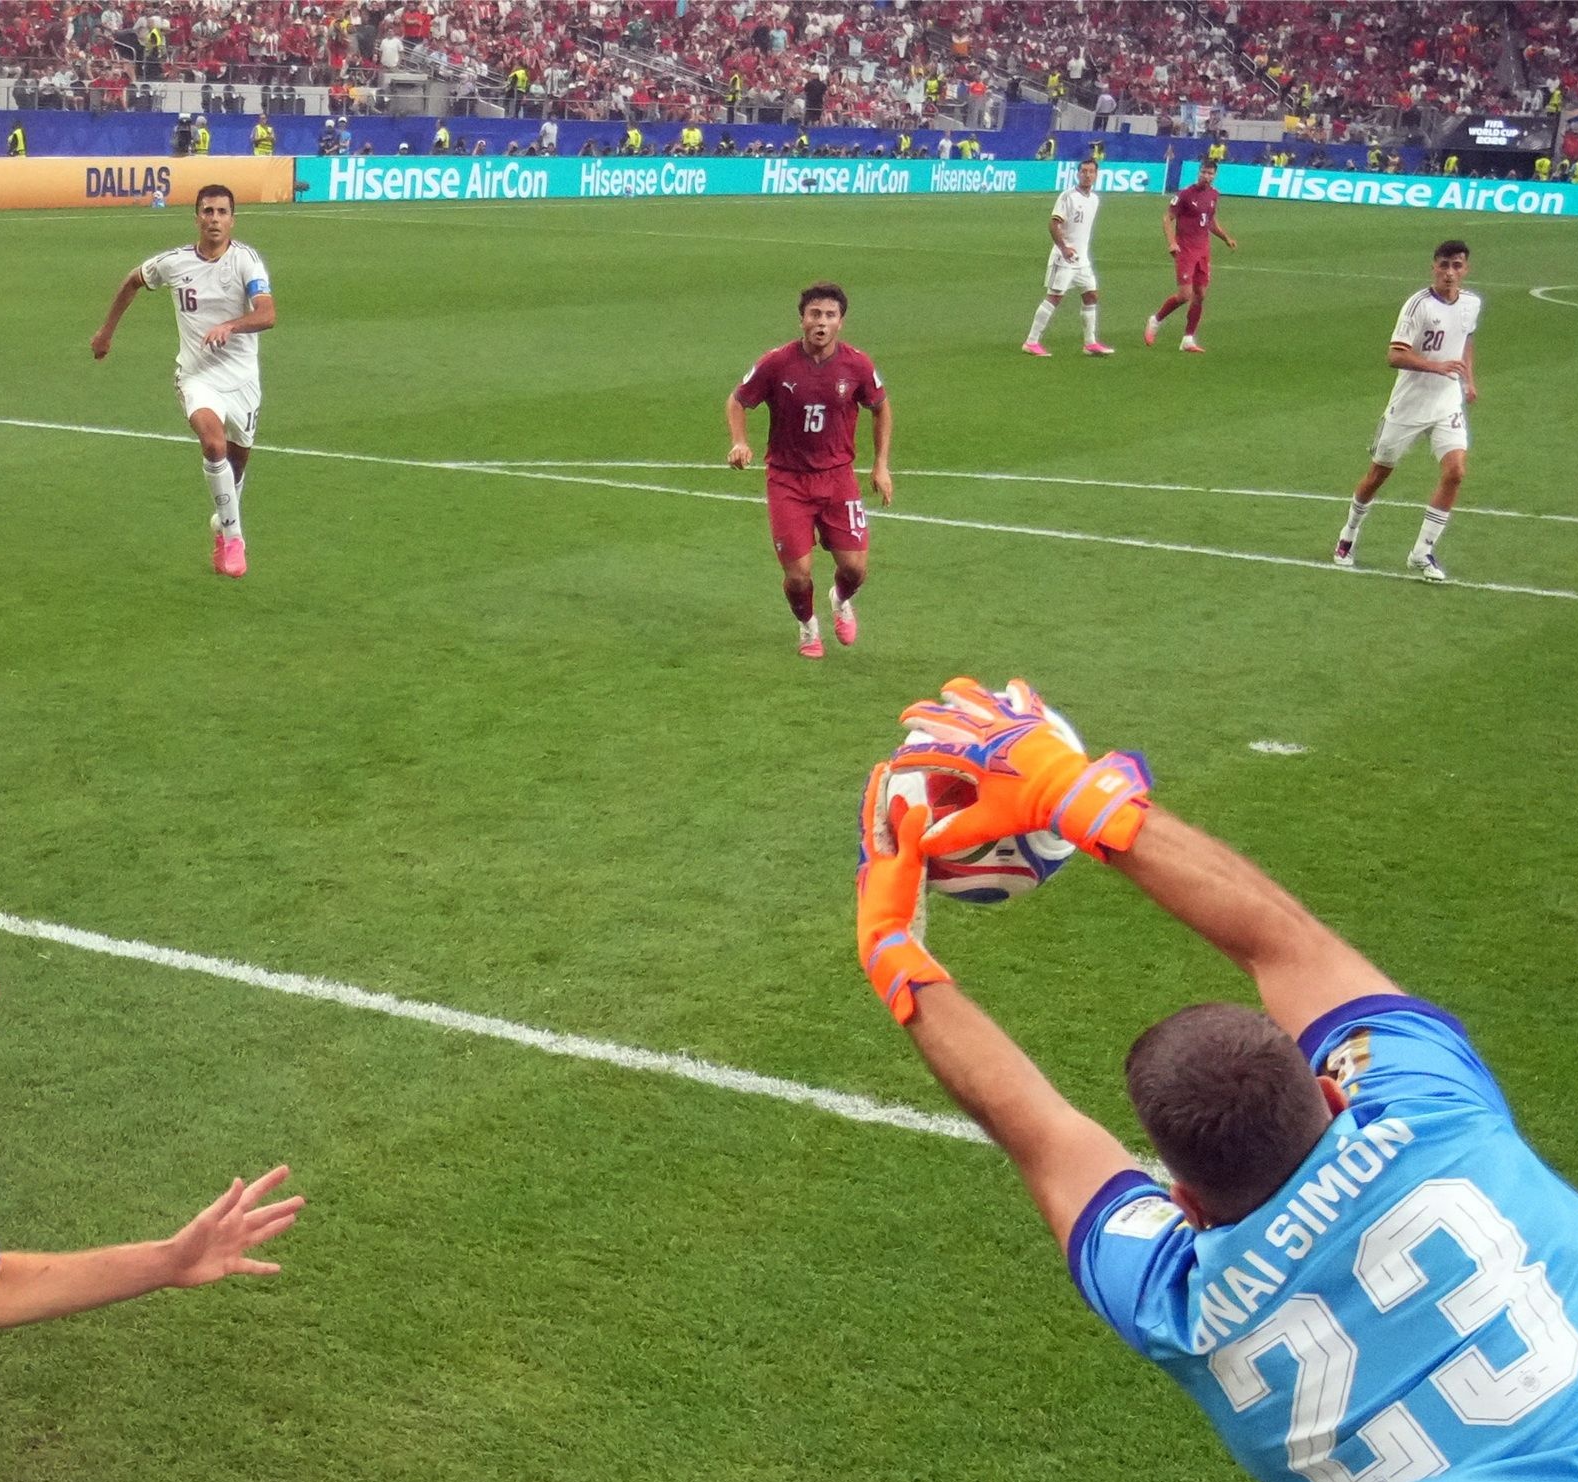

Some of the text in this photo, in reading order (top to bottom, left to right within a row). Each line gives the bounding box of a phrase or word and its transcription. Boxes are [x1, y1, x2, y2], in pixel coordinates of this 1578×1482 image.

[1468, 127, 1520, 137] WORLD CUP
[1484, 119, 1504, 129] FIFA
[86, 167, 171, 198] DALLAS
[329, 158, 548, 200] Hisense AirCon
[580, 160, 706, 196] Hisense Care
[762, 158, 909, 194] Hisense AirCon
[931, 161, 1016, 192] Hisense Care
[1258, 166, 1564, 214] Hisense AirCon
[1073, 211, 1084, 224] 21
[1199, 213, 1207, 227] 3
[178, 287, 198, 313] 16
[1422, 330, 1445, 351] 20
[803, 405, 826, 433] 15
[845, 500, 866, 529] 15
[1193, 1118, 1416, 1355] UNAI SIMÓN
